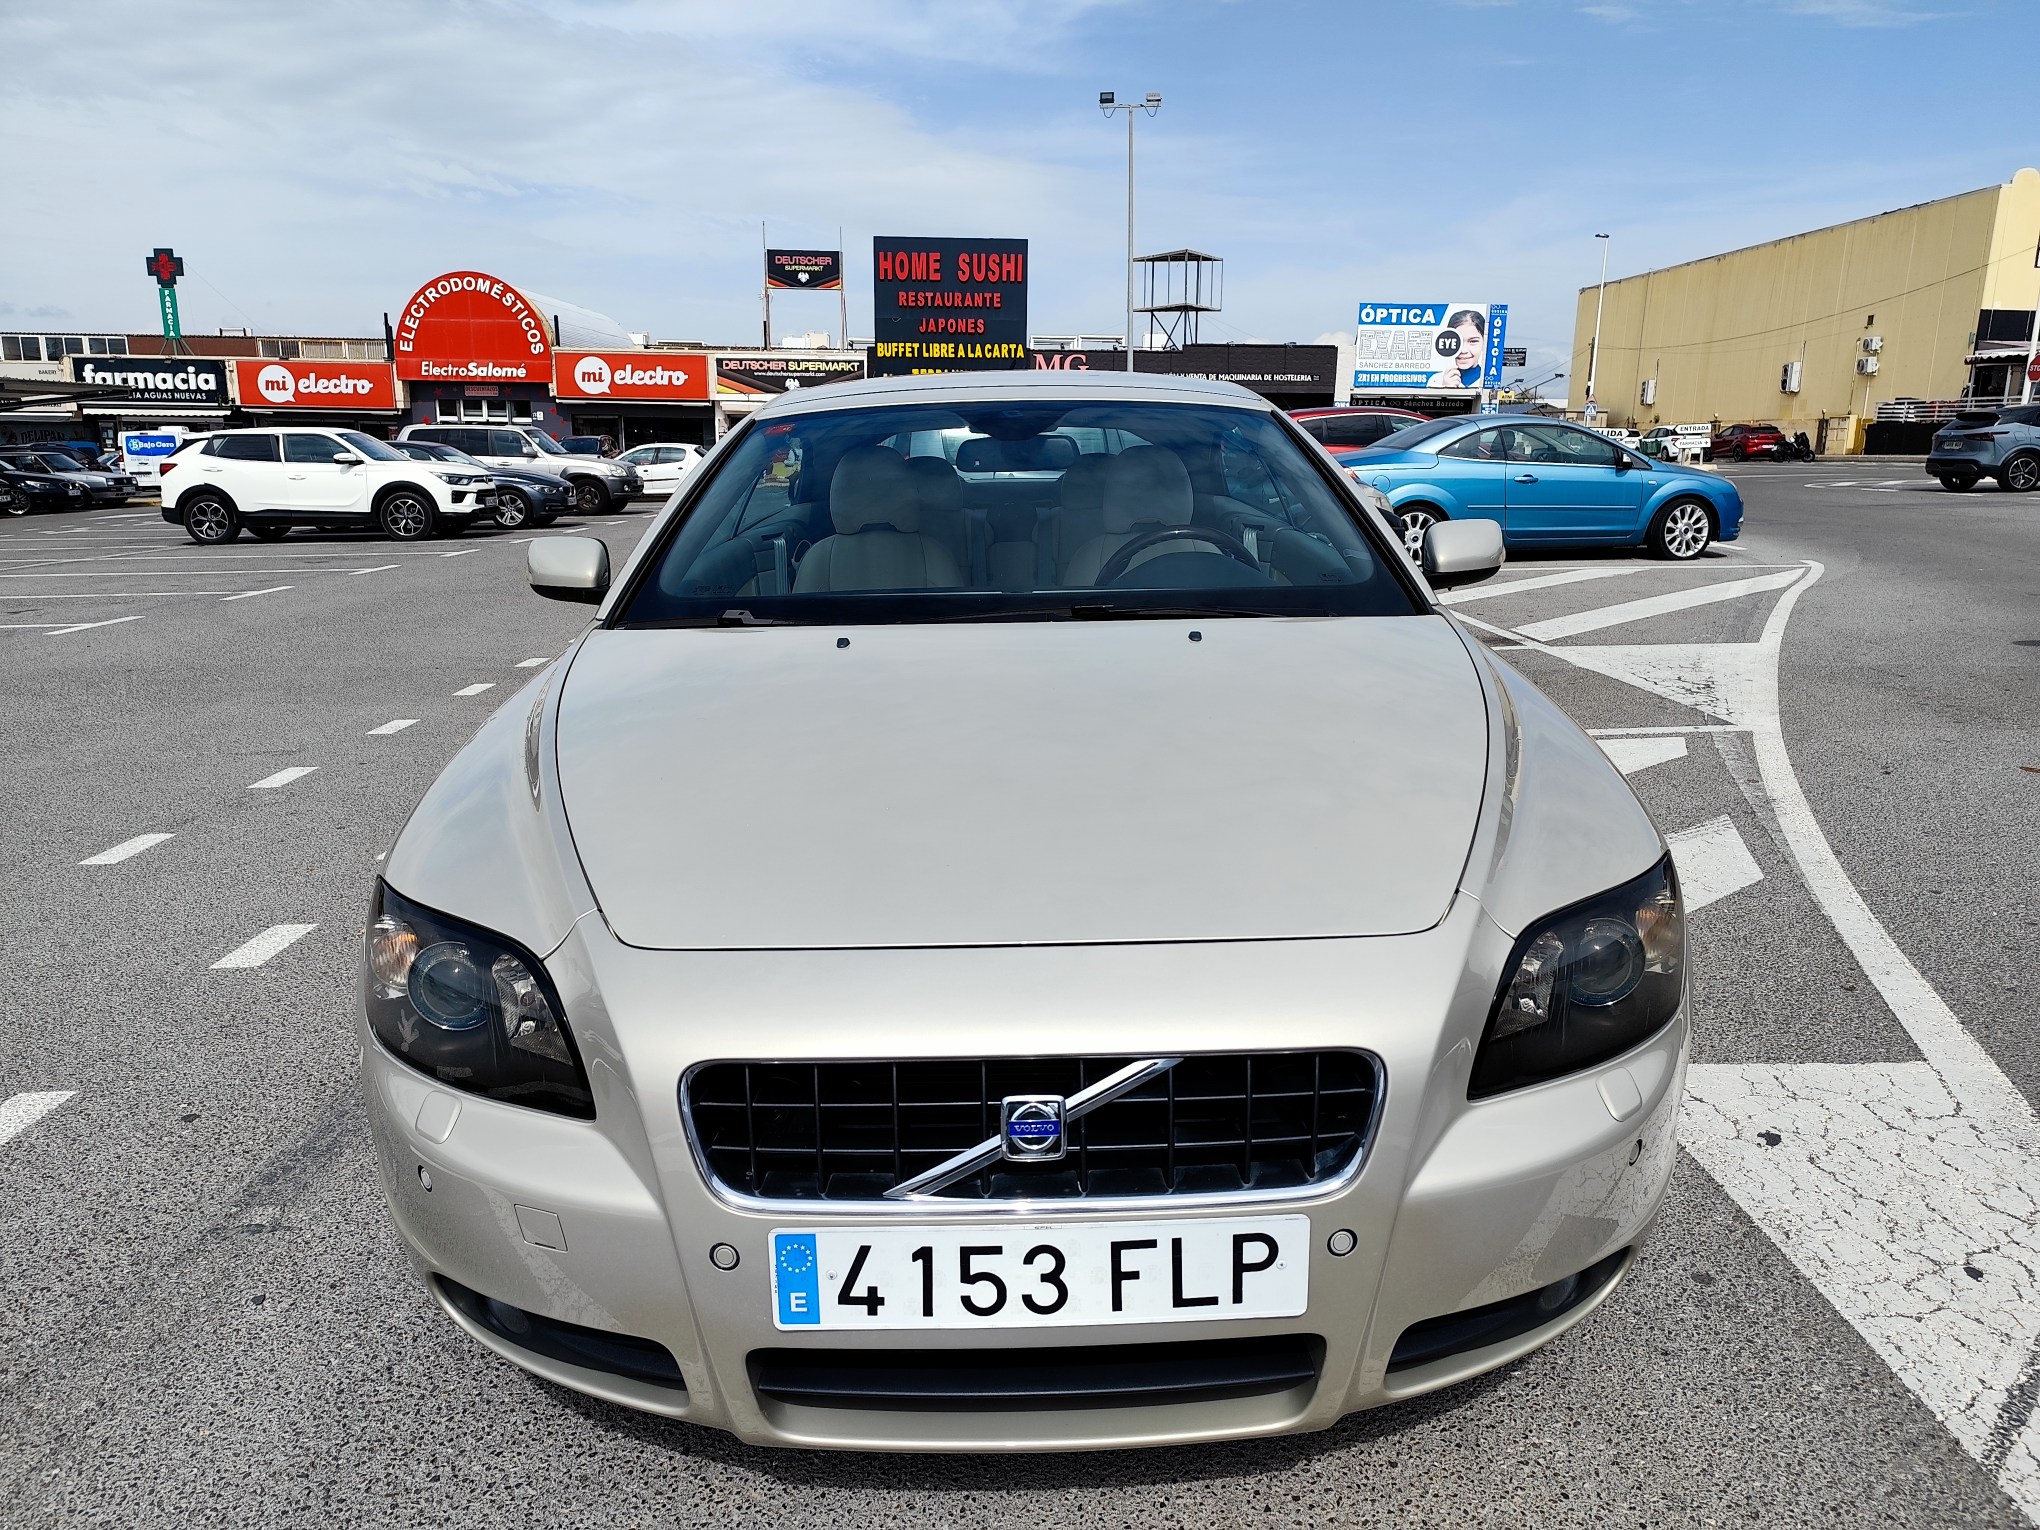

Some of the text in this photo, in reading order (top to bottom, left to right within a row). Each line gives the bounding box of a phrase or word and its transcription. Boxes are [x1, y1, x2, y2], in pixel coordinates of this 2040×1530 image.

[775, 256, 832, 265] DEUTSCHER
[879, 251, 1023, 282] HOME SUSHI
[898, 291, 1002, 307] RESTAURANTE
[400, 277, 544, 355] ELECTRODOMÉSTICOS
[1360, 305, 1436, 324] ÓPTICA
[919, 318, 985, 333] JAPONES
[877, 343, 1025, 358] BUFFET LIBRE A LA CARTA
[1438, 338, 1457, 349] EYE
[421, 361, 527, 377] ElectroSalomé
[723, 361, 859, 371] DEUTSCHER SUPERMARKT
[1032, 354, 1089, 370] MG
[83, 364, 217, 390] farmacia
[582, 364, 688, 385] mi electro
[1218, 373, 1262, 381] MAQUINARIA
[1357, 373, 1426, 383] 2X1 EN PROGRESIVOS
[265, 372, 373, 394] mi electro
[174, 392, 207, 400] NUEVAS
[1014, 1124, 1055, 1132] VOLVO
[837, 1232, 1280, 1317] 4153 FLP
[789, 1292, 808, 1312] E
